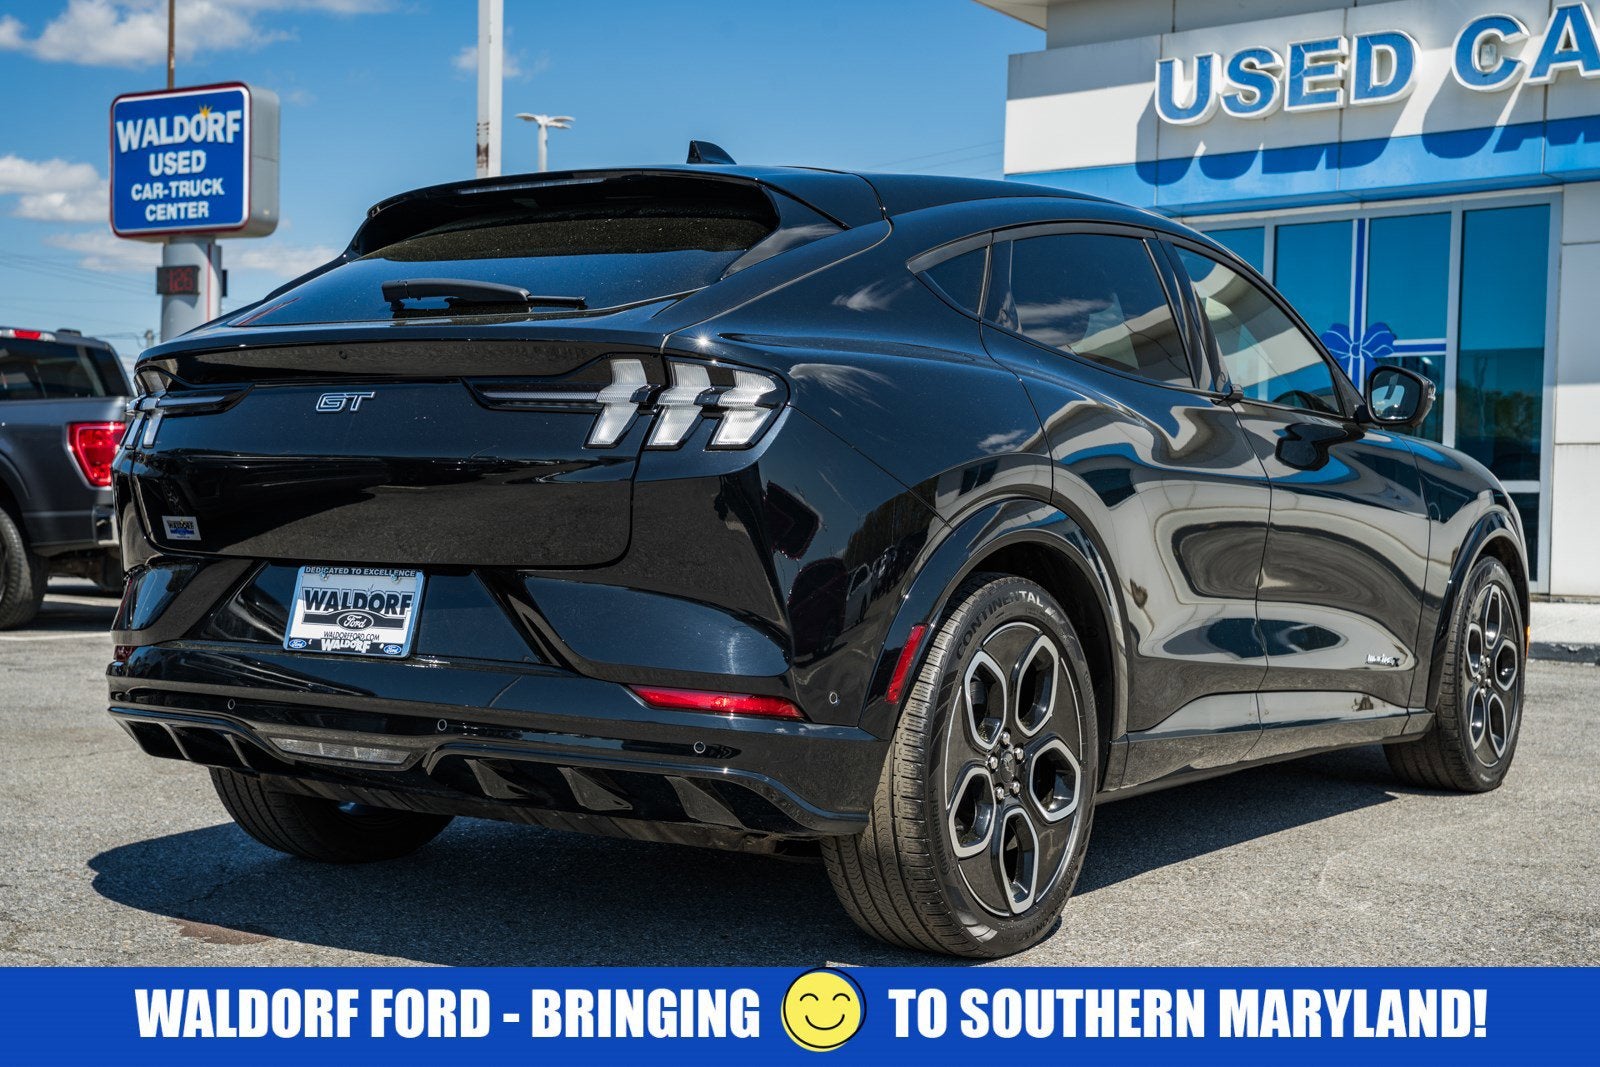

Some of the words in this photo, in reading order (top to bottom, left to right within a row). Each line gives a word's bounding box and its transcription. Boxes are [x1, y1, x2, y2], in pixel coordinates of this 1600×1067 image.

[1155, 29, 1424, 126] USED
[116, 109, 242, 153] WALDORF
[149, 149, 207, 177] USED
[131, 178, 225, 201] CAR-TRUCK
[145, 201, 209, 222] CENTER
[316, 391, 376, 412] GT
[305, 566, 350, 575] DEDICATED
[363, 568, 416, 577] EXCELLENCE
[303, 588, 414, 616] WALDORF
[343, 615, 366, 629] Ford
[321, 638, 371, 653] WALDORF
